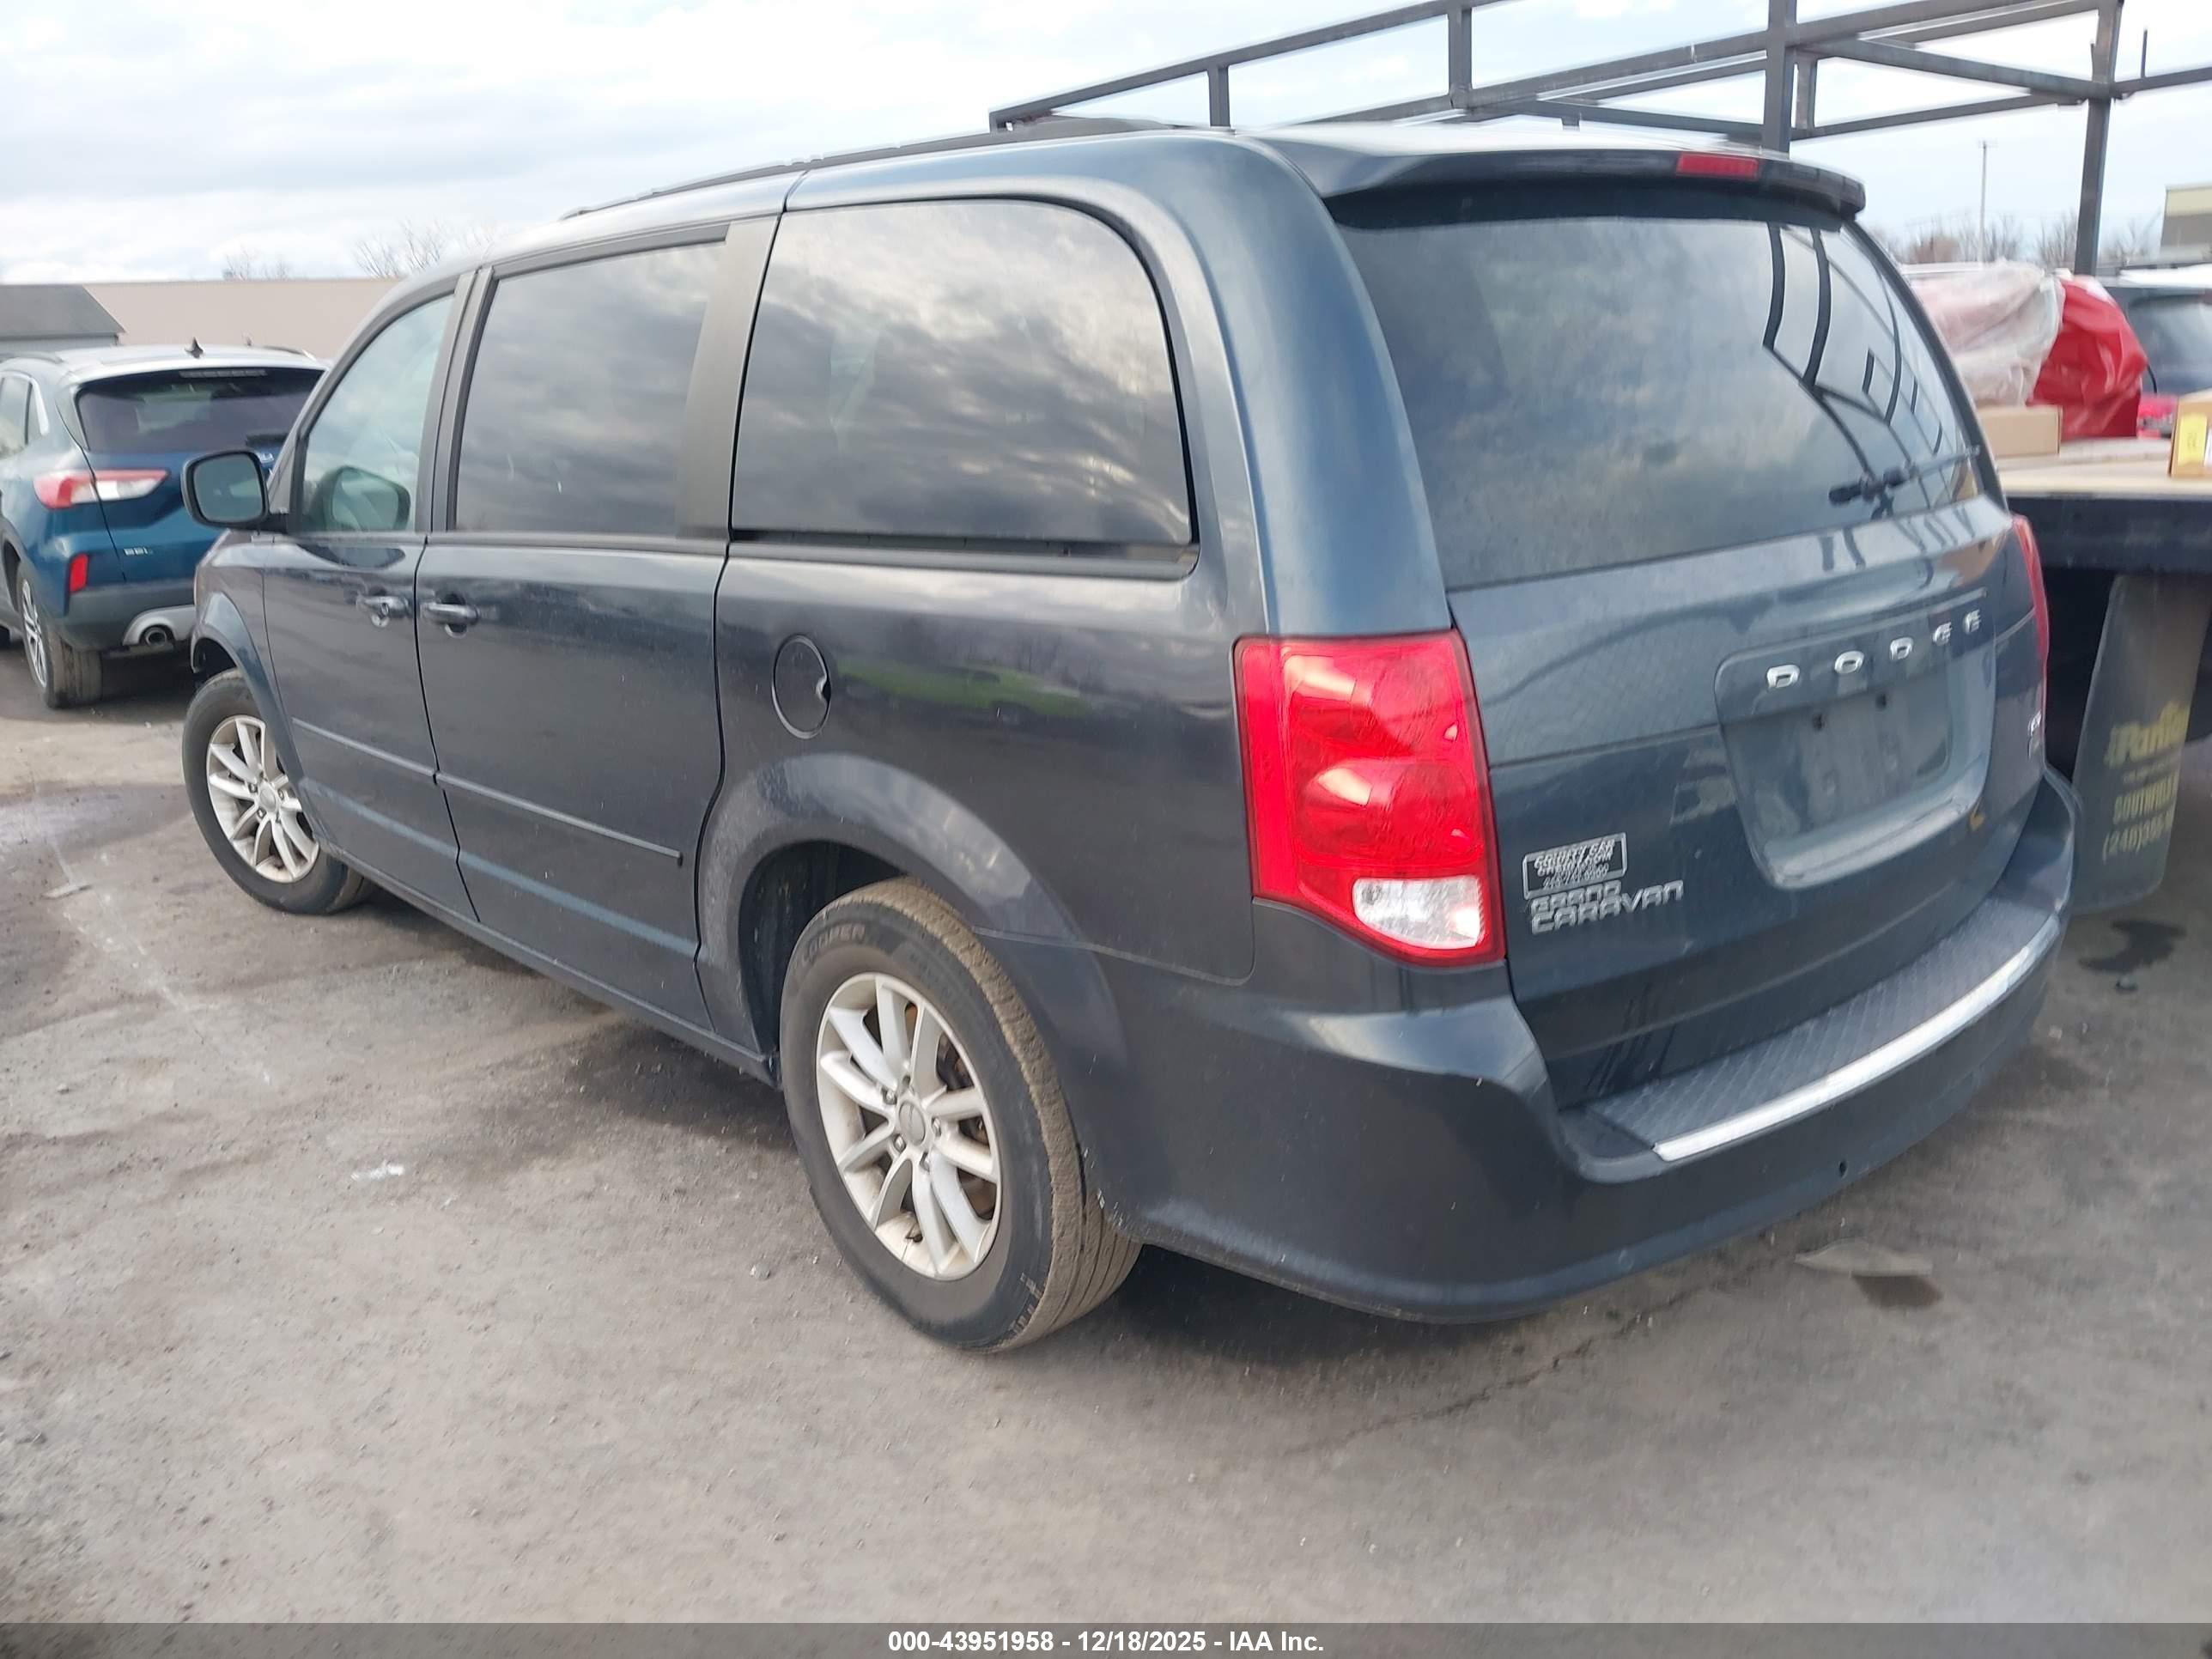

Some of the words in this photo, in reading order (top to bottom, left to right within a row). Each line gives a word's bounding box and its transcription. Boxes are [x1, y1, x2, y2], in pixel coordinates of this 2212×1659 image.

[1766, 608, 1981, 689] DODGE
[1530, 879, 1621, 916] GRAND
[1531, 879, 1684, 934] CARAVAN
